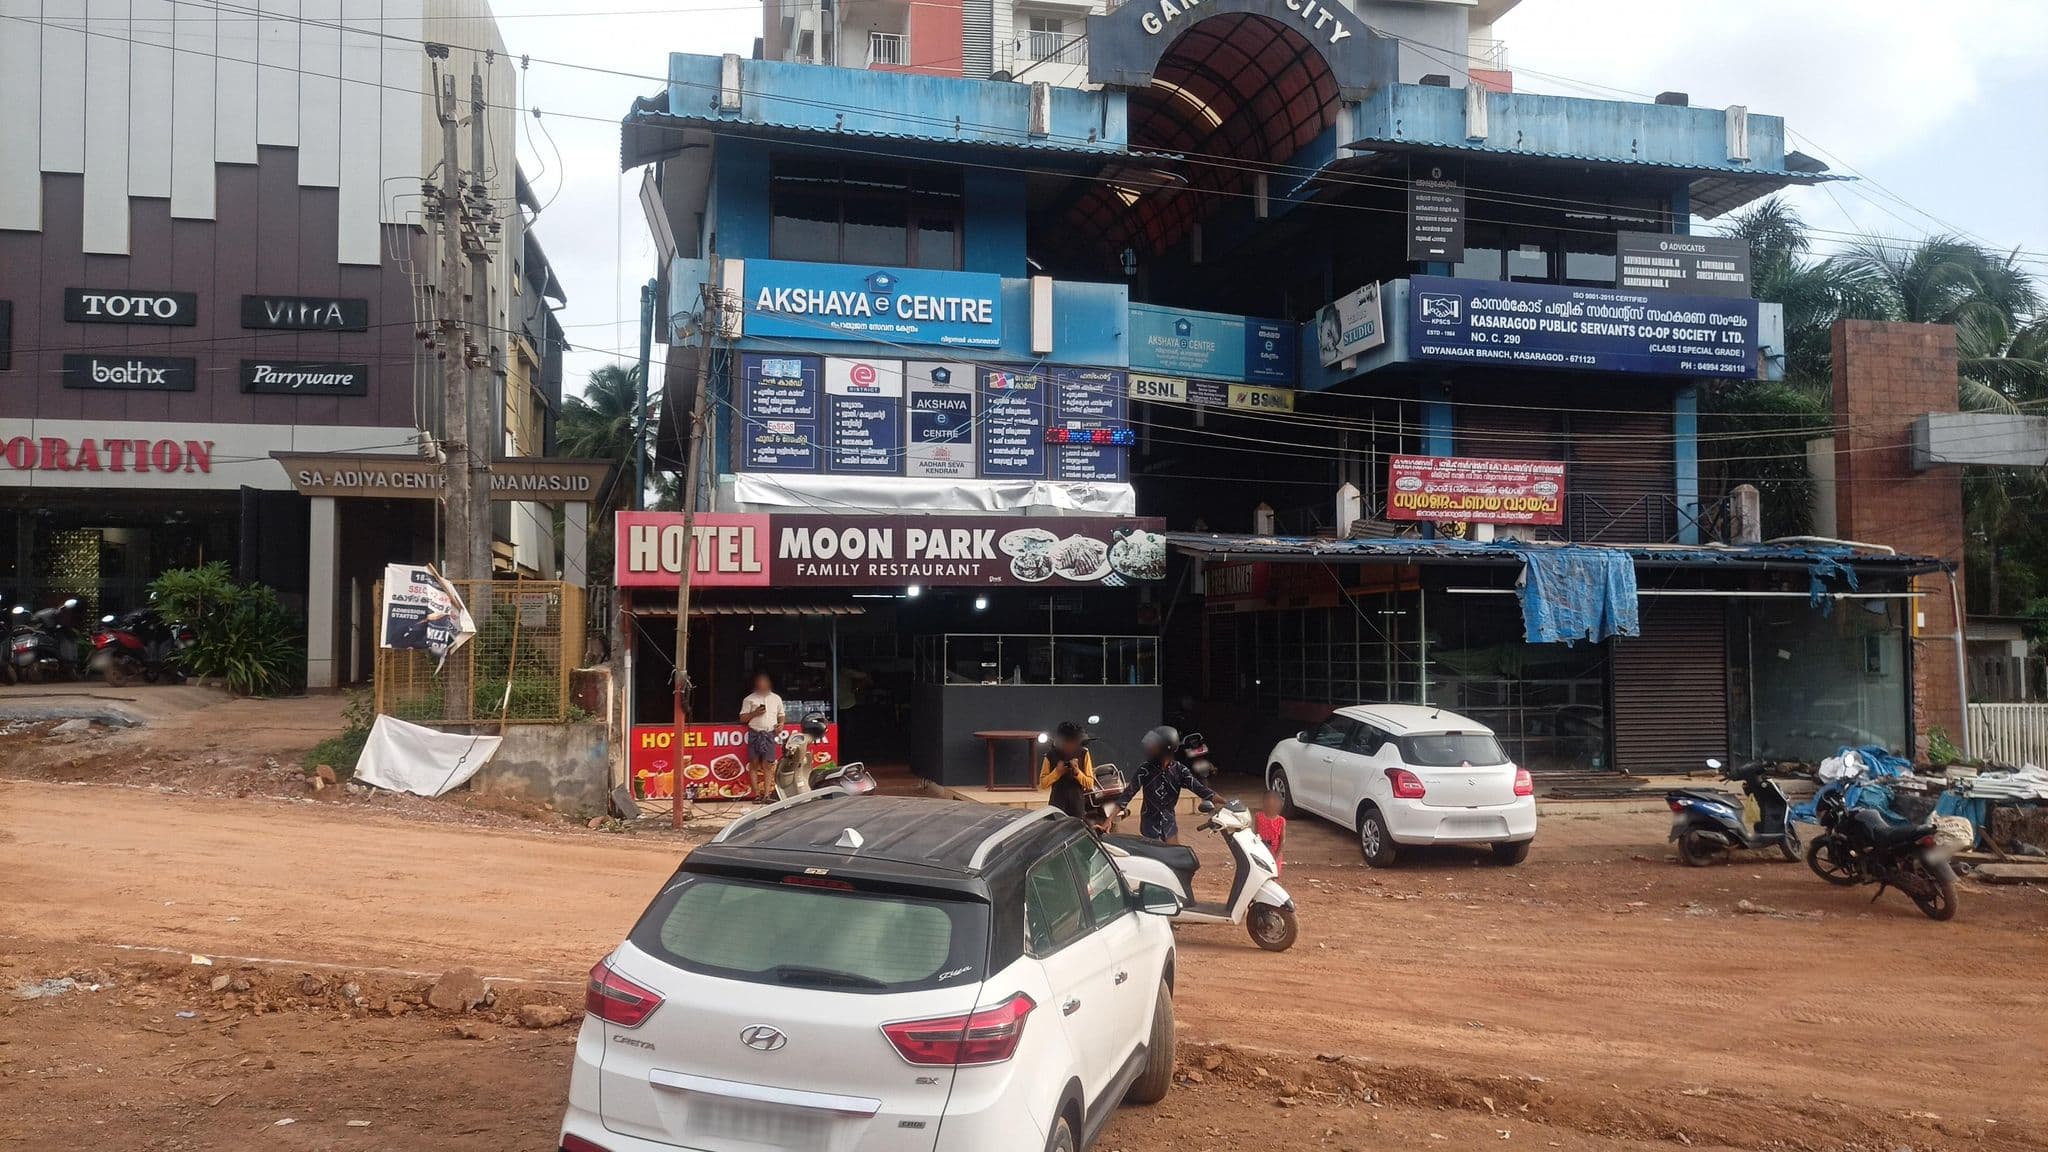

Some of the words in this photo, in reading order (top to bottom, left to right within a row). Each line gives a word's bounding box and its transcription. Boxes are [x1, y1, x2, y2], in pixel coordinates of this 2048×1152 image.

[1286, 0, 1351, 43] CITY
[1669, 243, 1706, 252] ADVOCATES
[83, 295, 177, 320] TOTO
[756, 286, 871, 318] AKSHAYA
[896, 294, 993, 324] CENTRE
[1615, 295, 1648, 304] CERTIFIED
[1647, 306, 1706, 325] സഹകരണ
[1709, 311, 1748, 328] സംഘം
[1344, 322, 1374, 345] STUDIO
[1470, 314, 1537, 330] KASARAGOD
[1539, 319, 1578, 333] PUBLIC
[1581, 322, 1637, 337] SERVANTS
[1639, 326, 1671, 339] CO-OP
[1673, 327, 1718, 342] SOCIETY
[1723, 332, 1745, 344] LTD.
[1148, 336, 1179, 347] AKSHAYA
[1188, 340, 1216, 352] CENTRE
[1470, 333, 1489, 343] NO.
[1491, 333, 1501, 343] C.
[1504, 334, 1520, 344] 290
[1421, 346, 1474, 358] VIDYANAGAR
[1476, 349, 1511, 360] BRANCH,
[1513, 352, 1563, 363] KASARAGOD
[1570, 355, 1596, 365] 671123
[1649, 345, 1676, 354] (CLASS
[1682, 347, 1713, 357] SPECIAL
[1715, 348, 1741, 358] GRADE
[91, 360, 166, 386] bathx
[252, 365, 354, 390] Parryware
[1137, 380, 1179, 399] BSNL
[917, 399, 967, 410] AKSHAYA
[923, 429, 959, 438] CENTRE
[300, 471, 385, 488] SA-ADIYA
[522, 476, 590, 492] MASJID
[629, 525, 761, 572] HOTEL
[779, 526, 894, 560] MOON
[905, 528, 998, 560] PARK
[796, 564, 860, 576] FAMILY
[869, 564, 980, 577] RESTAURANT
[391, 607, 426, 615] ADMISSION
[642, 732, 708, 748] HOEL
[613, 1034, 656, 1051] CRETA
[915, 1077, 939, 1085] SX
